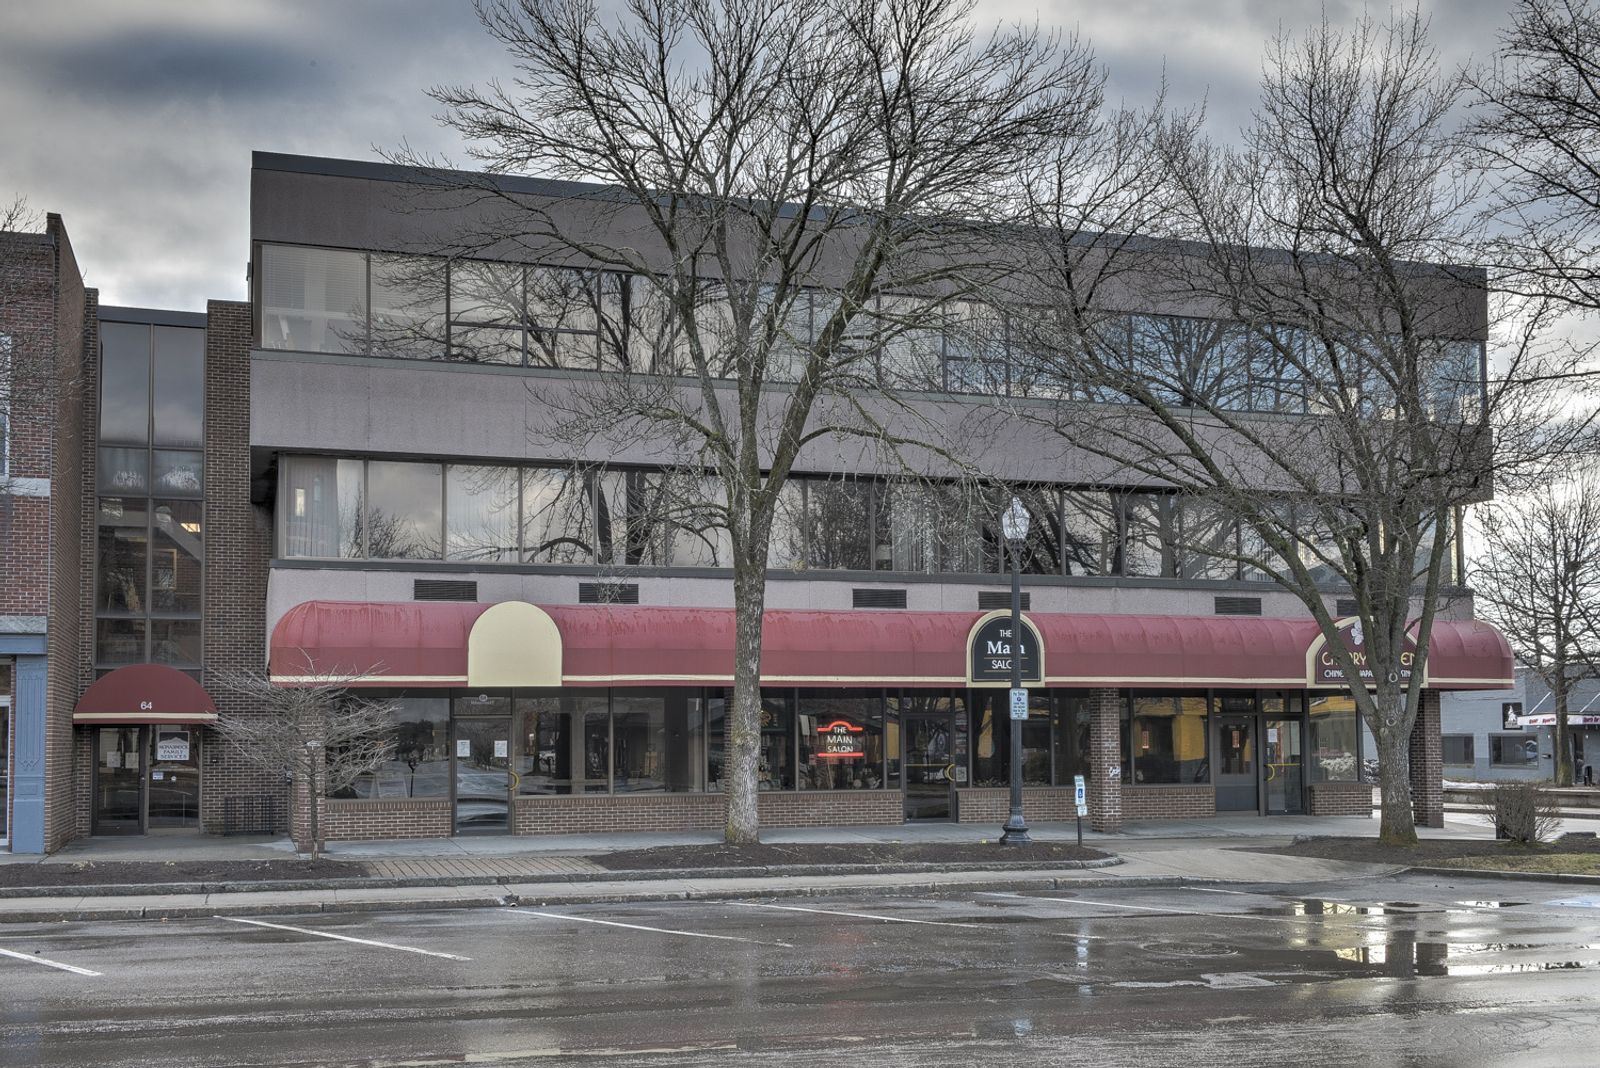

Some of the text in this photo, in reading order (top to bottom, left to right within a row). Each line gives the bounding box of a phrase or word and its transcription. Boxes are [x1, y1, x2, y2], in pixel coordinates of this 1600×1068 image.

[1000, 629, 1012, 637] THE
[987, 641, 1025, 654] Man
[991, 660, 1012, 669] SALO
[140, 701, 152, 710] 64
[827, 735, 852, 744] MAIN
